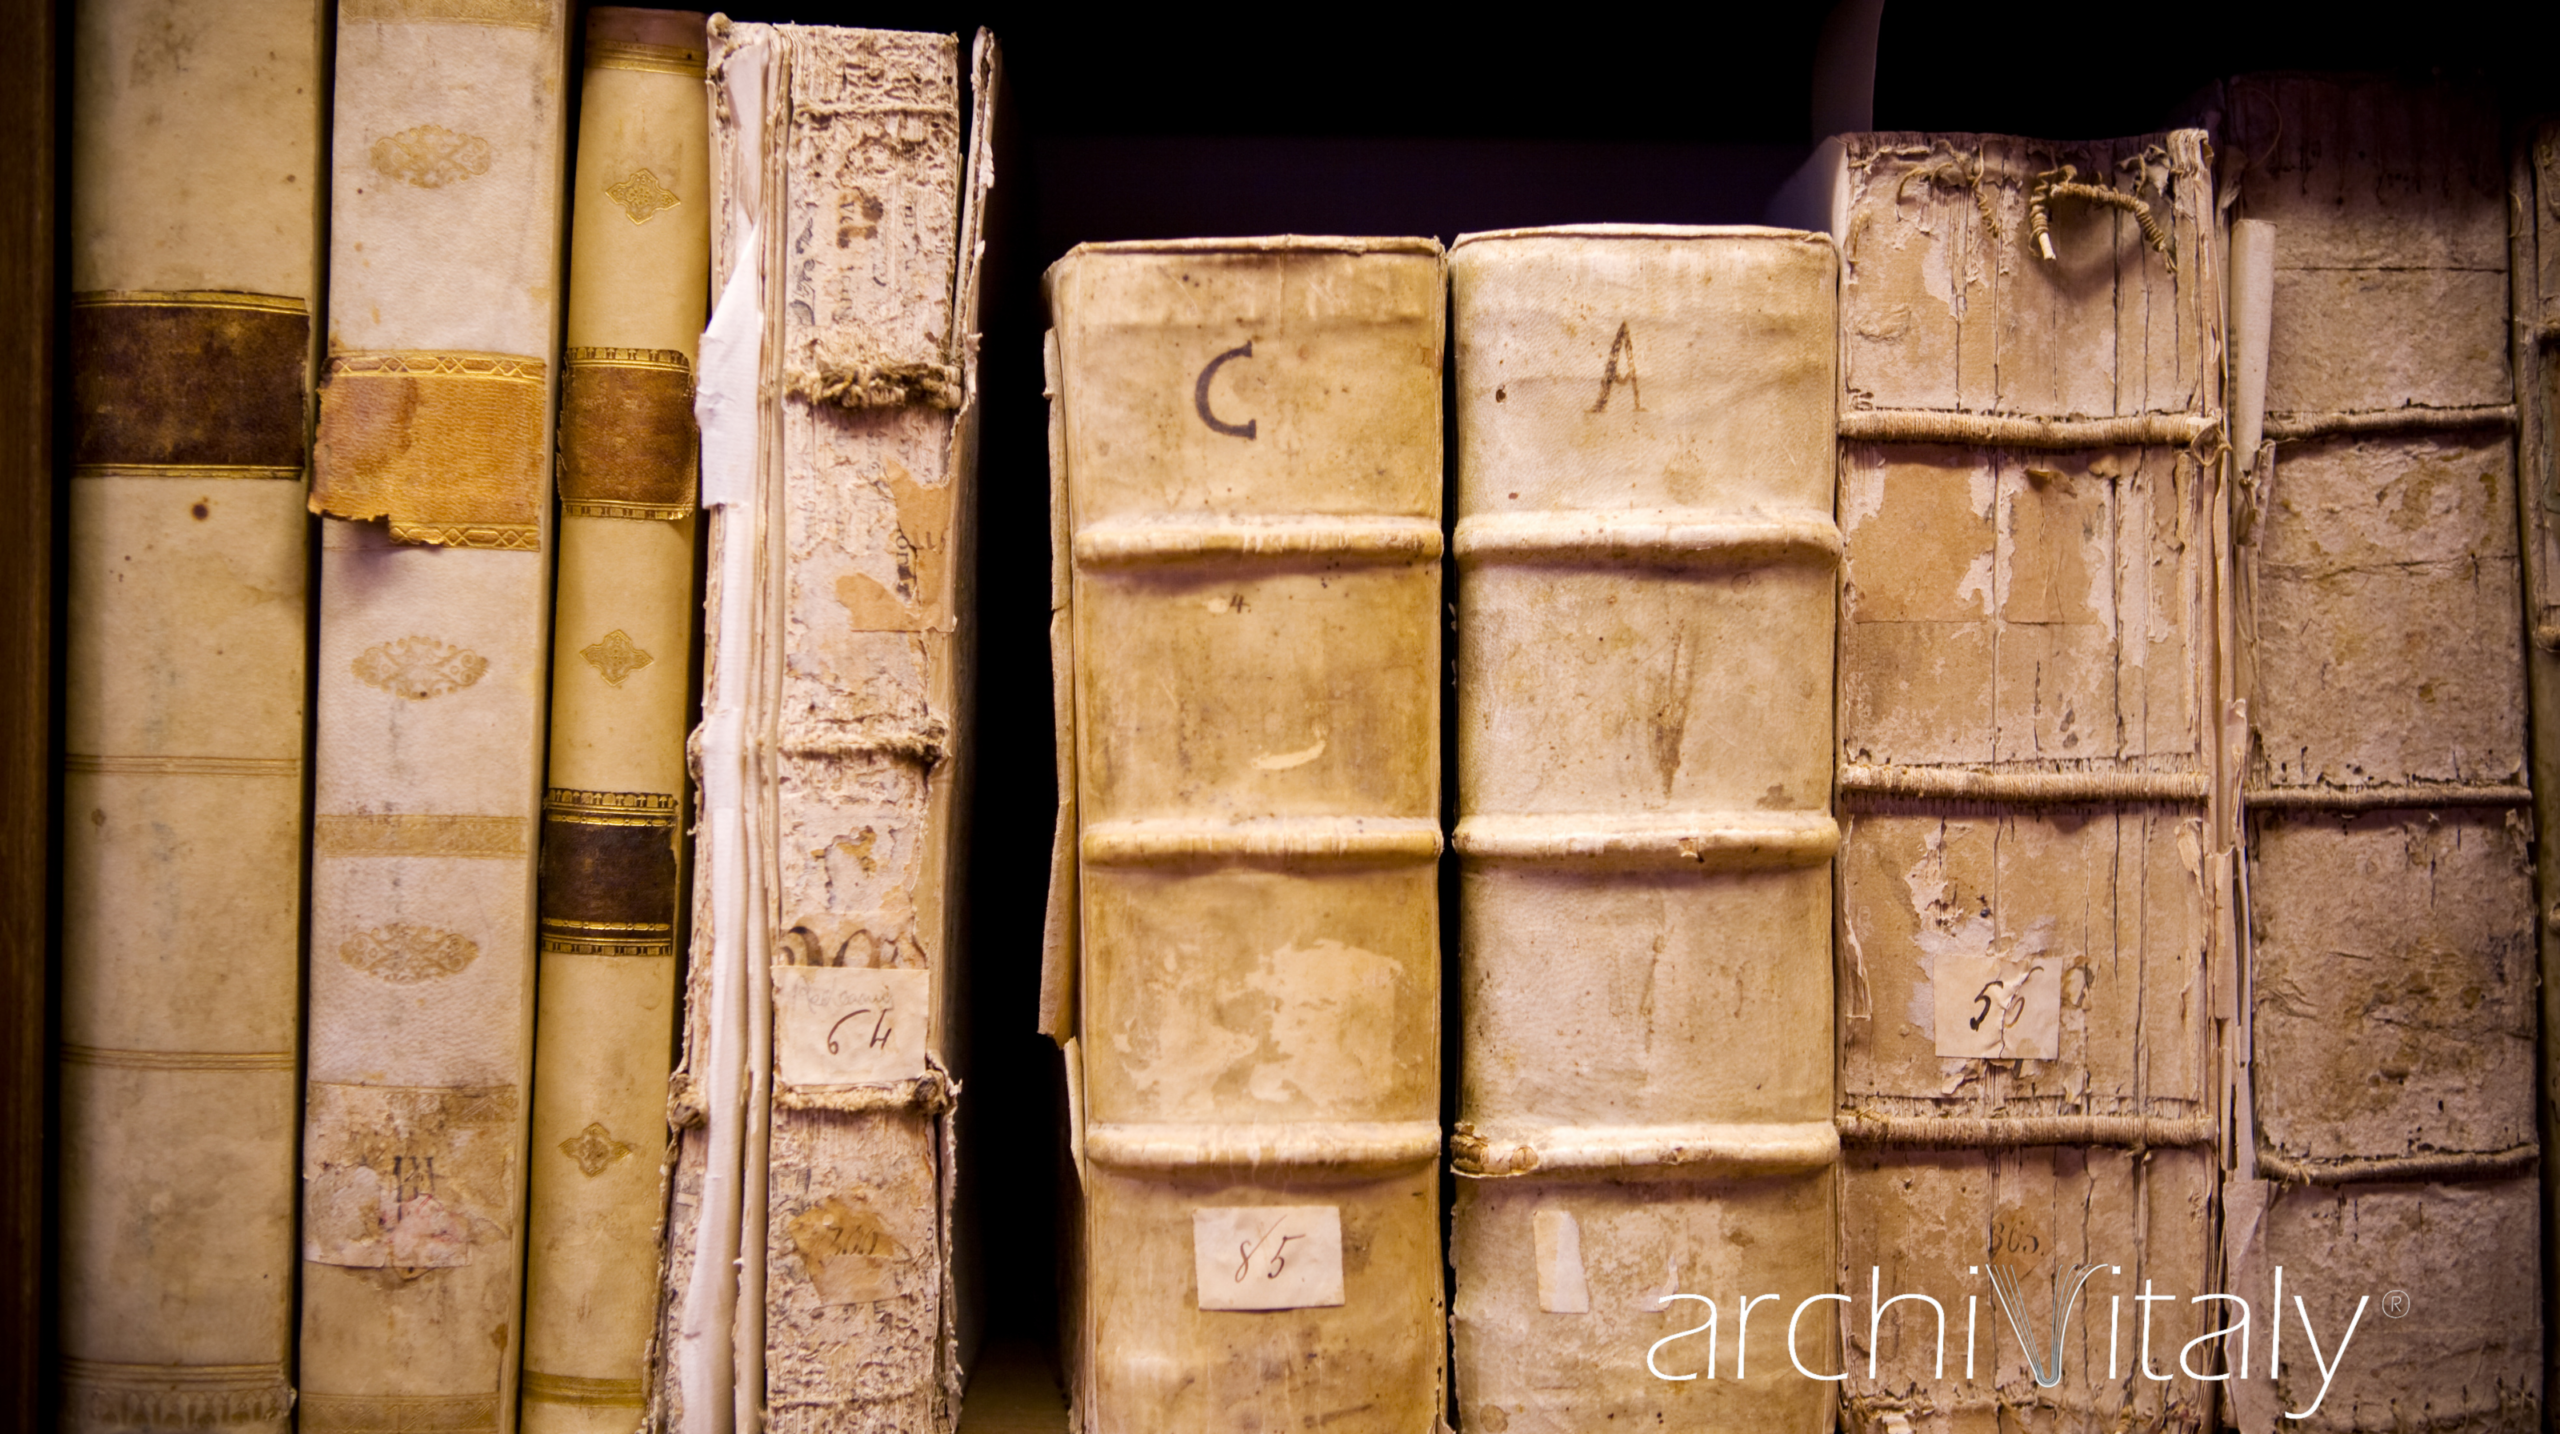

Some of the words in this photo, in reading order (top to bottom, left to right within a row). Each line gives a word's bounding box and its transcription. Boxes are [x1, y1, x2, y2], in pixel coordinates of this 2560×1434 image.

[1194, 340, 1257, 441] C
[1583, 321, 1648, 413] A
[827, 1008, 893, 1055] 64
